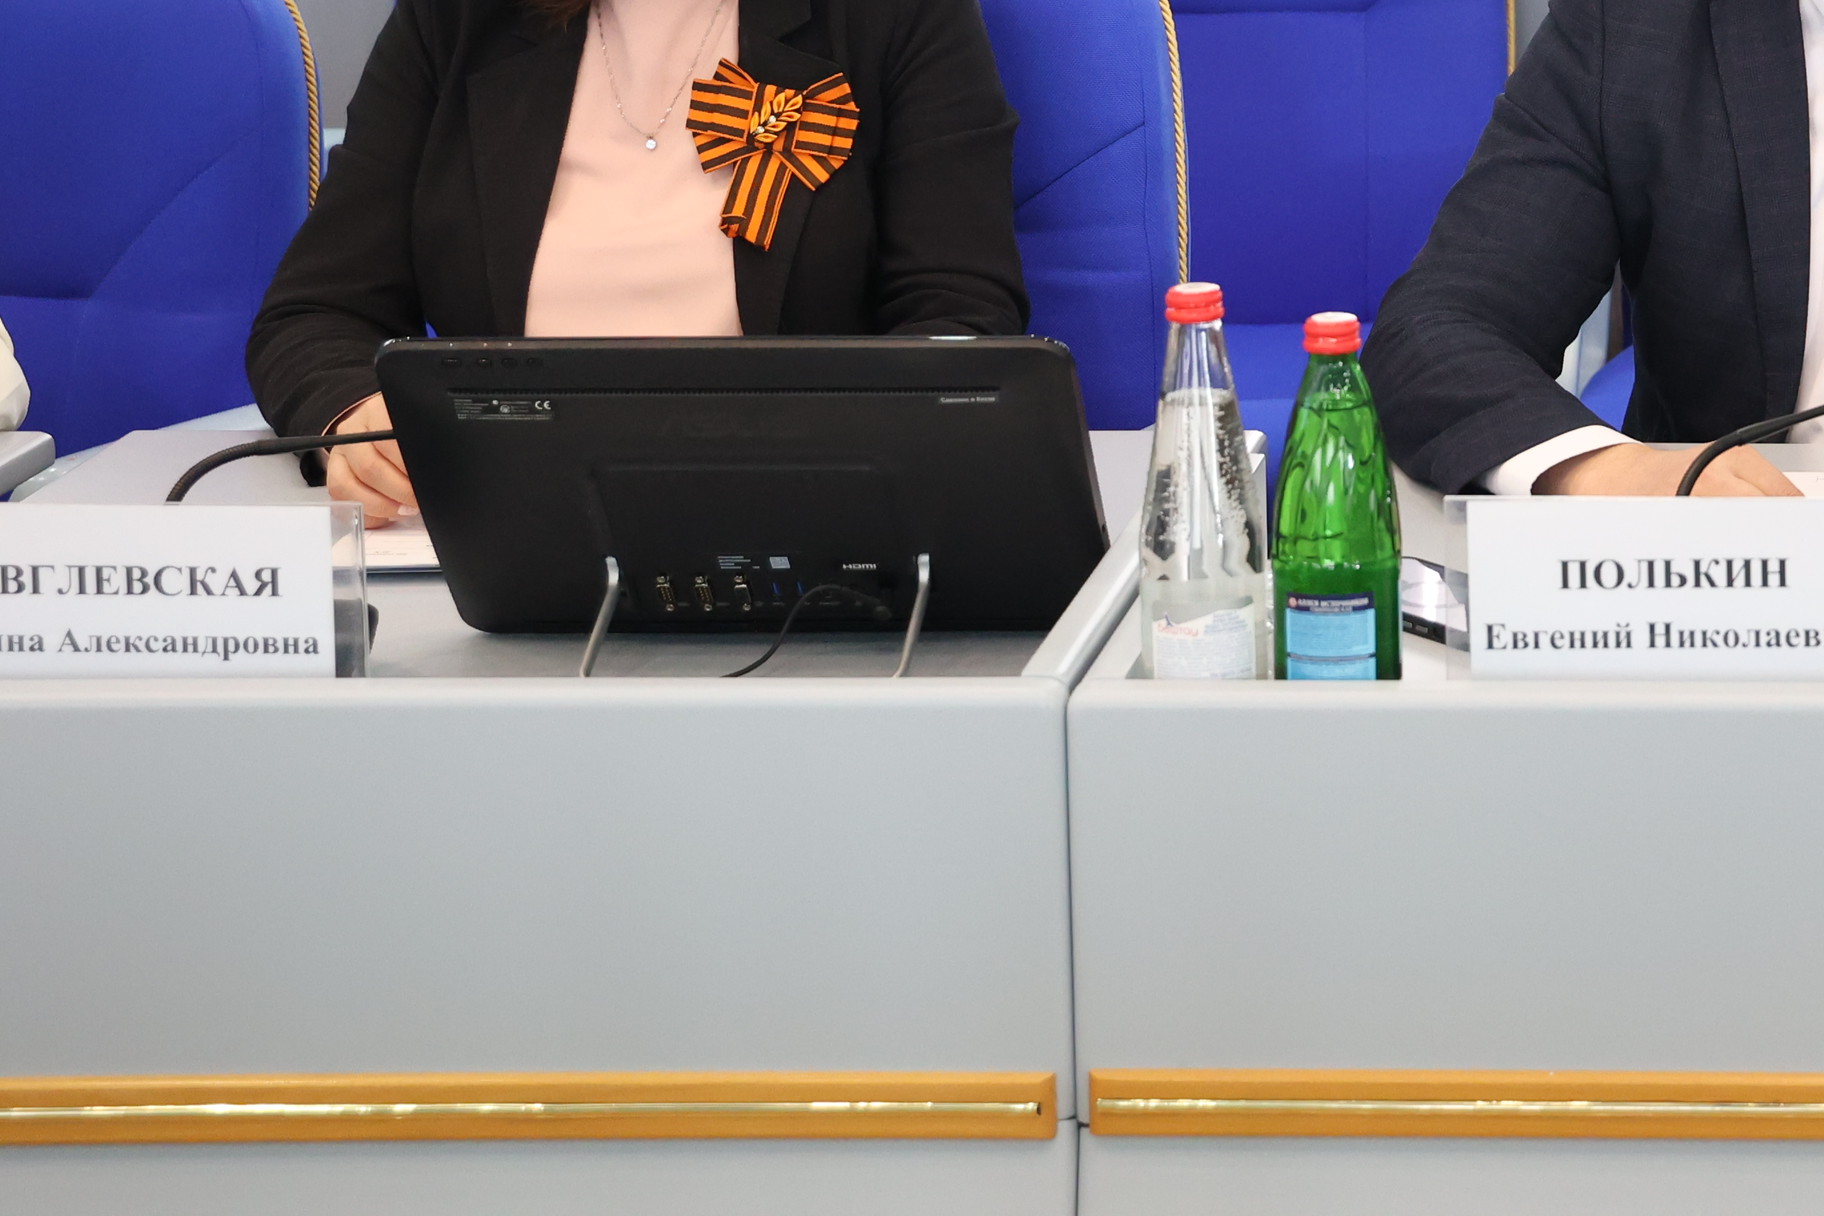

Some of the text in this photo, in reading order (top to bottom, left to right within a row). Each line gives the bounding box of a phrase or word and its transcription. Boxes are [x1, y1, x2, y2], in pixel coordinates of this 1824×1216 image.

[0, 564, 282, 597] ВГЛЕВСКАЯ
[842, 562, 877, 570] HDMI
[1558, 558, 1790, 590] ПОЛЬКИН
[57, 628, 320, 662] Александровна
[1485, 622, 1634, 651] Евгений
